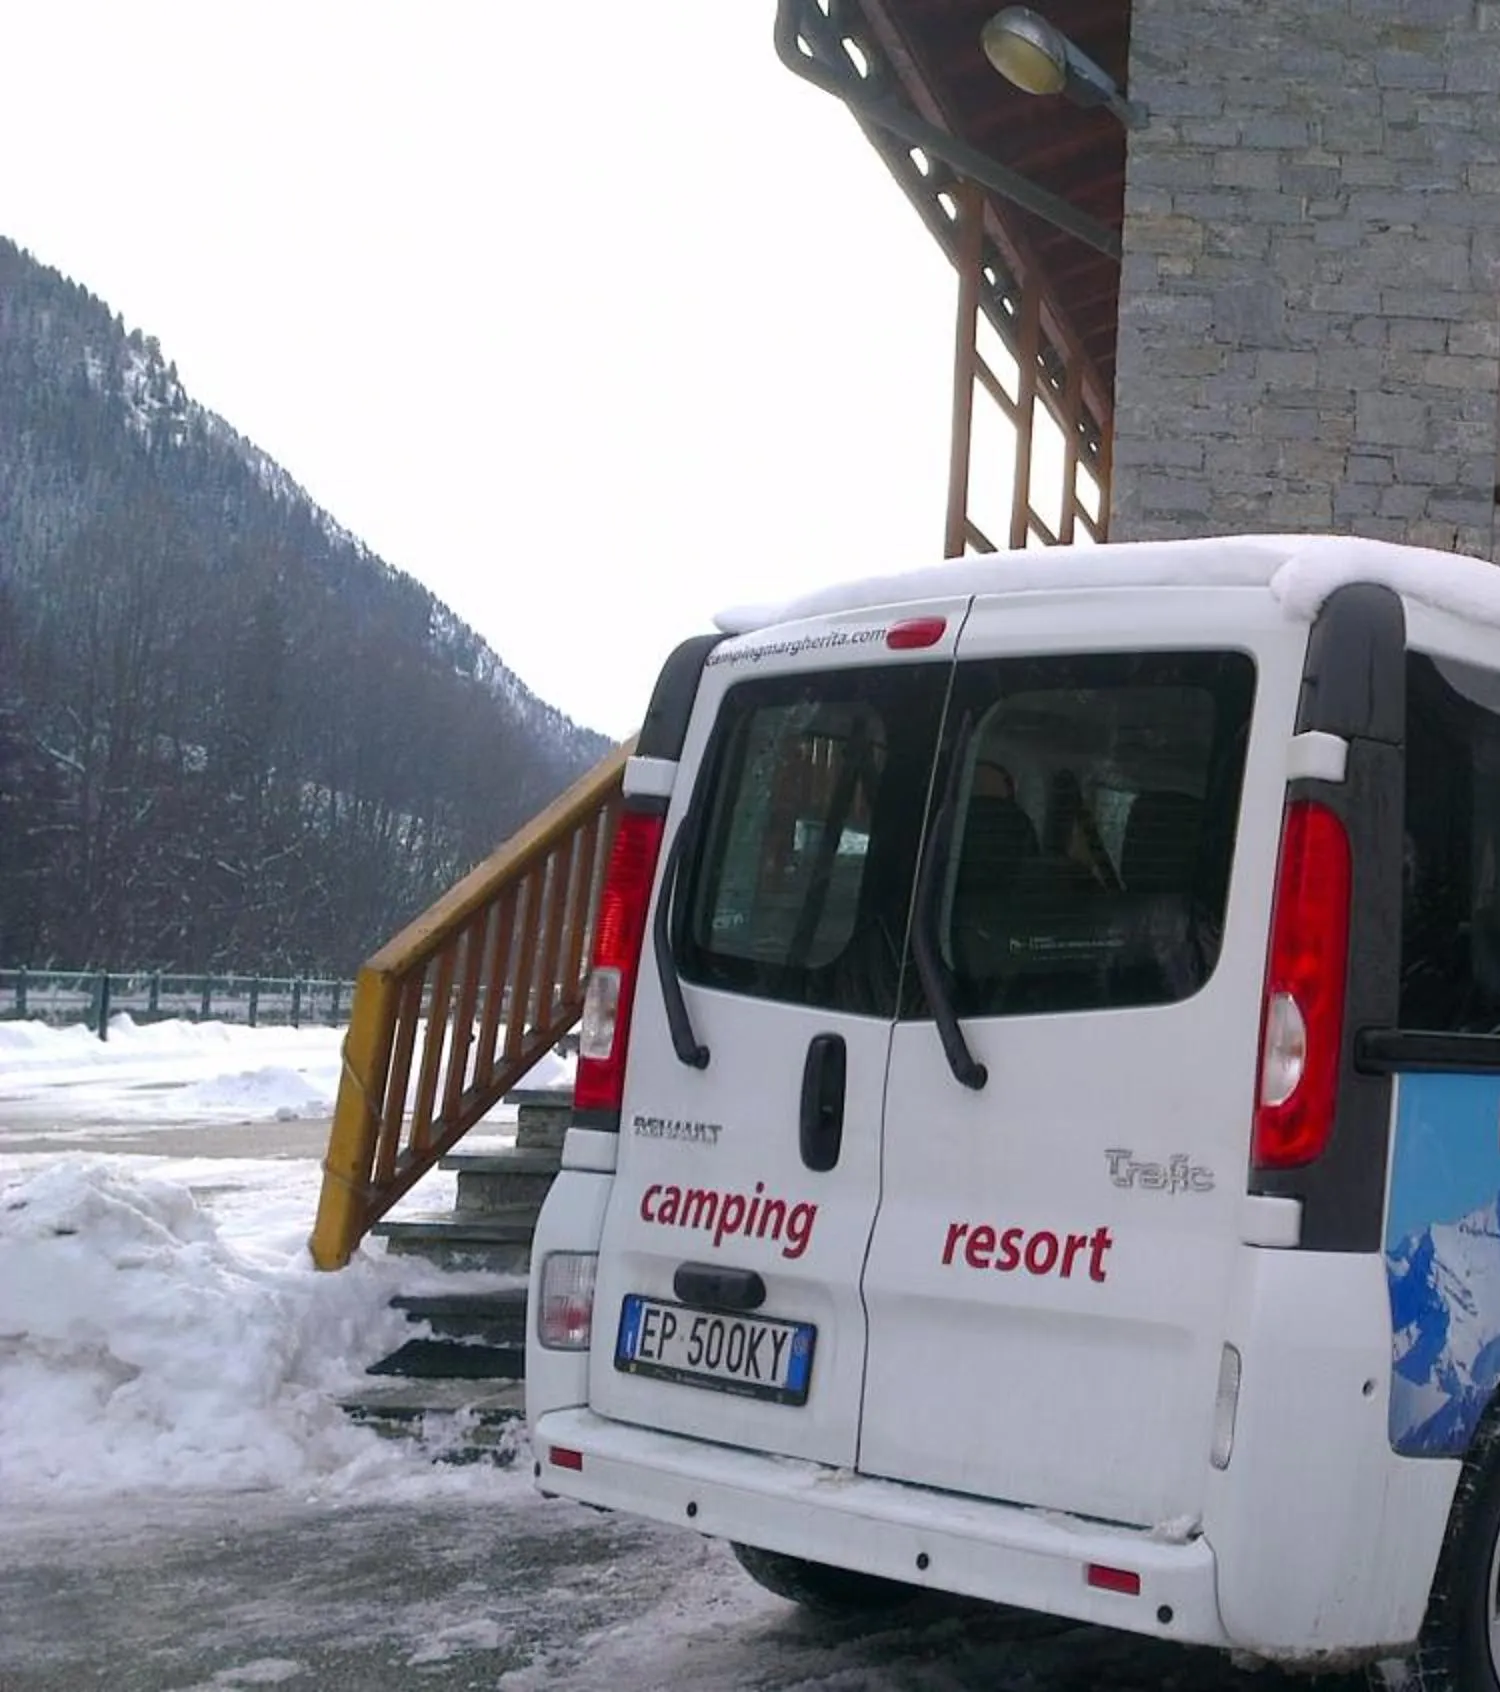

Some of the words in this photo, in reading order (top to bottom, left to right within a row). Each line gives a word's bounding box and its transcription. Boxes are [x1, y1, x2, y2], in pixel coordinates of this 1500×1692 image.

[1104, 1148, 1217, 1194] Trafic
[640, 1181, 818, 1259] camping
[942, 1220, 1113, 1283] resort
[639, 1308, 677, 1361] EP
[687, 1316, 788, 1382] 500KY
